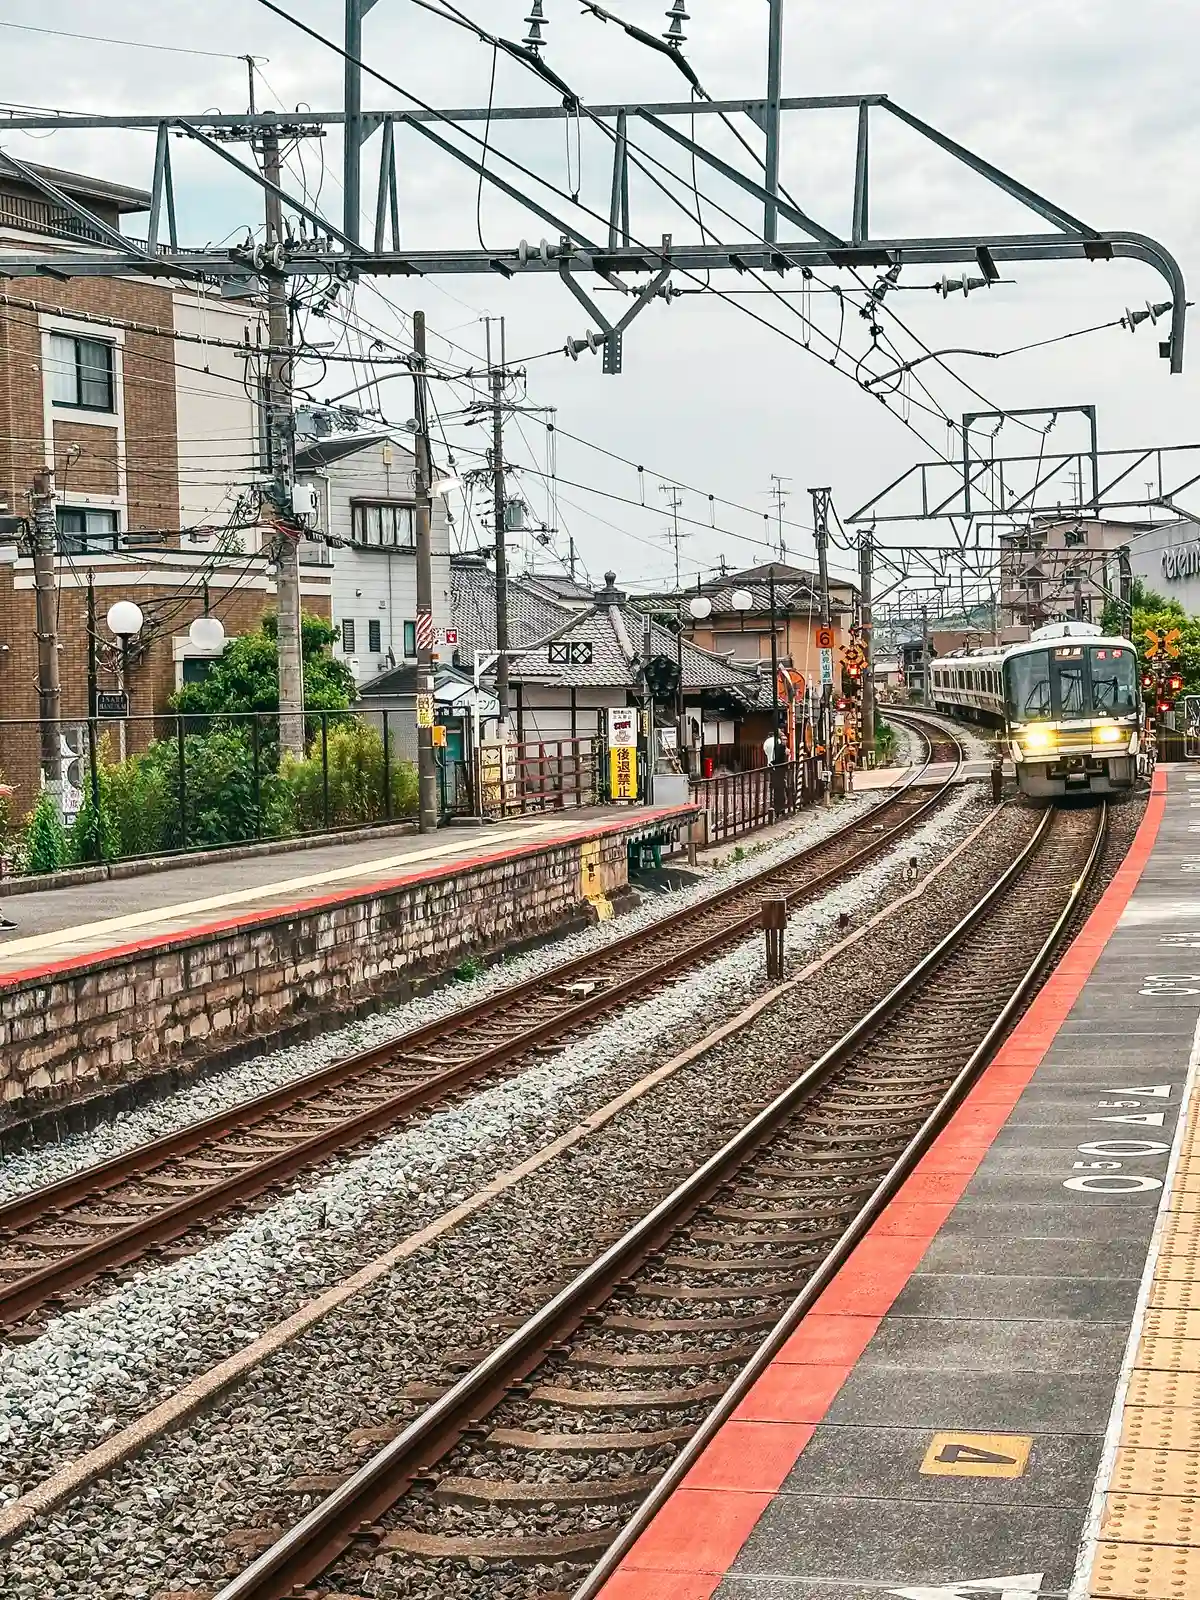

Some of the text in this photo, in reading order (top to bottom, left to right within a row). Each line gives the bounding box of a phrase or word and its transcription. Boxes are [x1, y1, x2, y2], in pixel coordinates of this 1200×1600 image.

[820, 632, 830, 645] 6
[616, 748, 632, 798] 後退禁止
